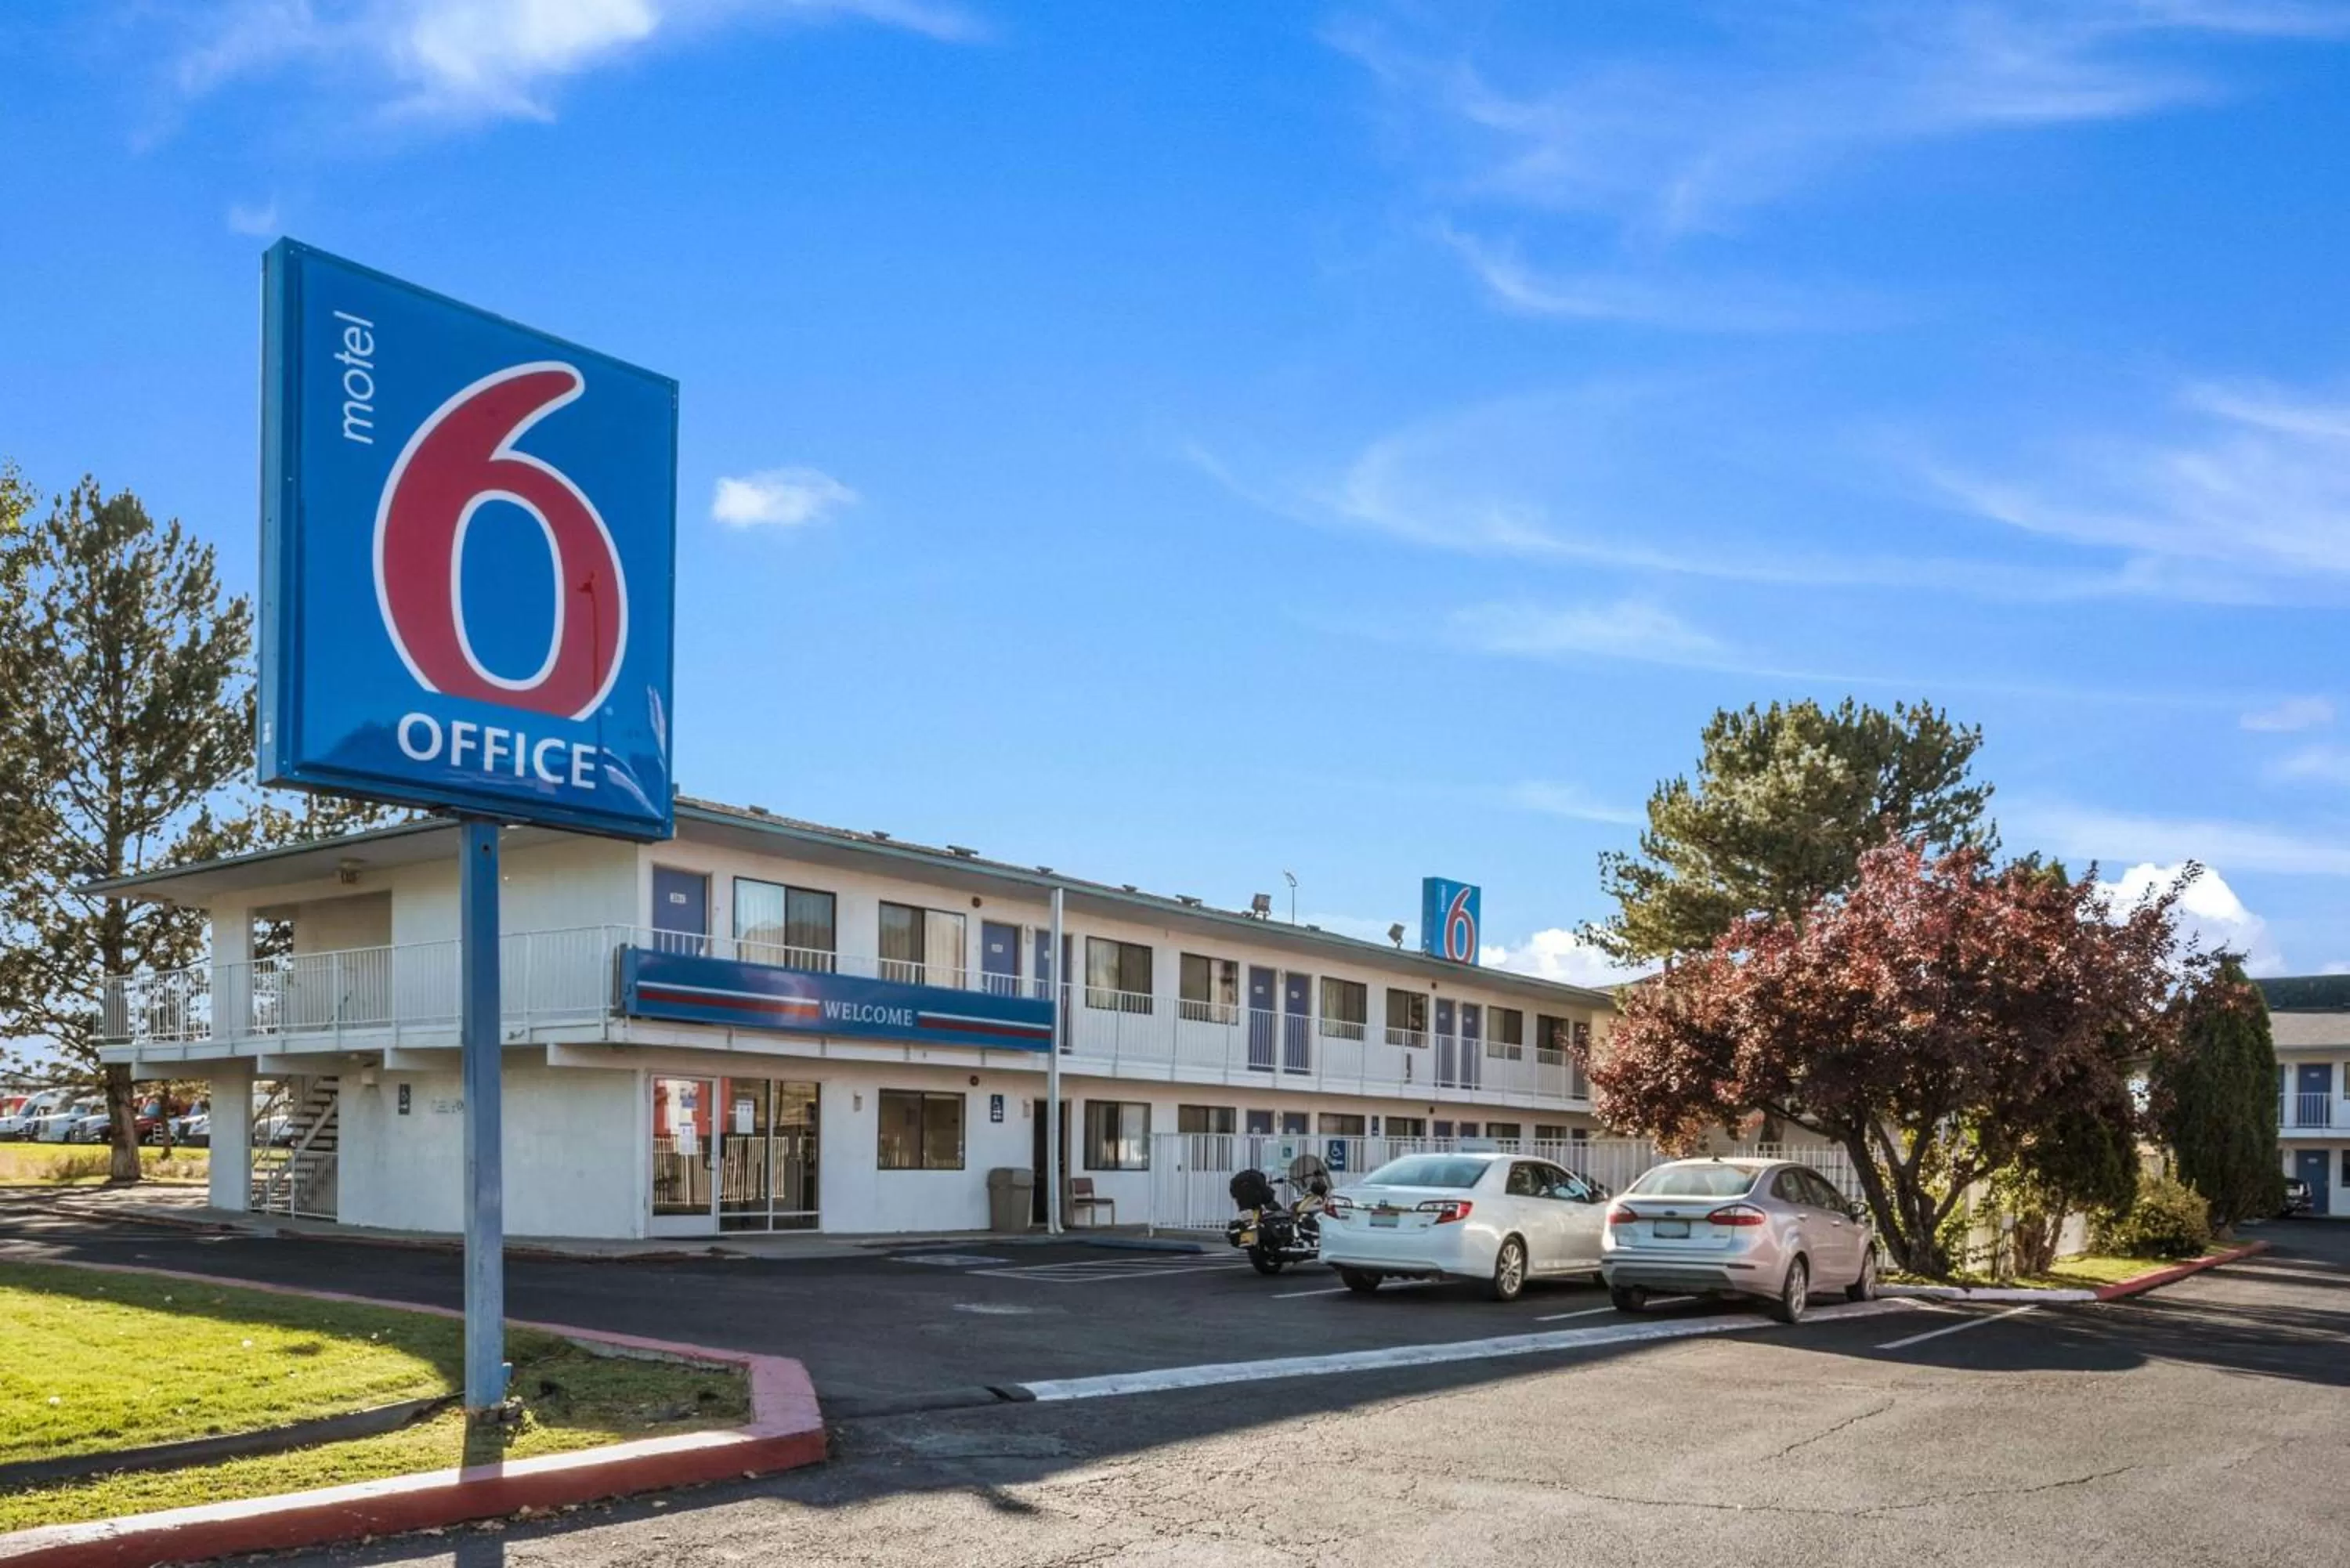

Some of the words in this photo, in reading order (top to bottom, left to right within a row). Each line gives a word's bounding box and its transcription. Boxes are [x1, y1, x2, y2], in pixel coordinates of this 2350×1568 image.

[334, 310, 374, 445] motel
[373, 361, 627, 721] 6
[398, 713, 596, 789] OFFICE
[1444, 887, 1476, 964] 6
[825, 1000, 913, 1027] WELCOME
